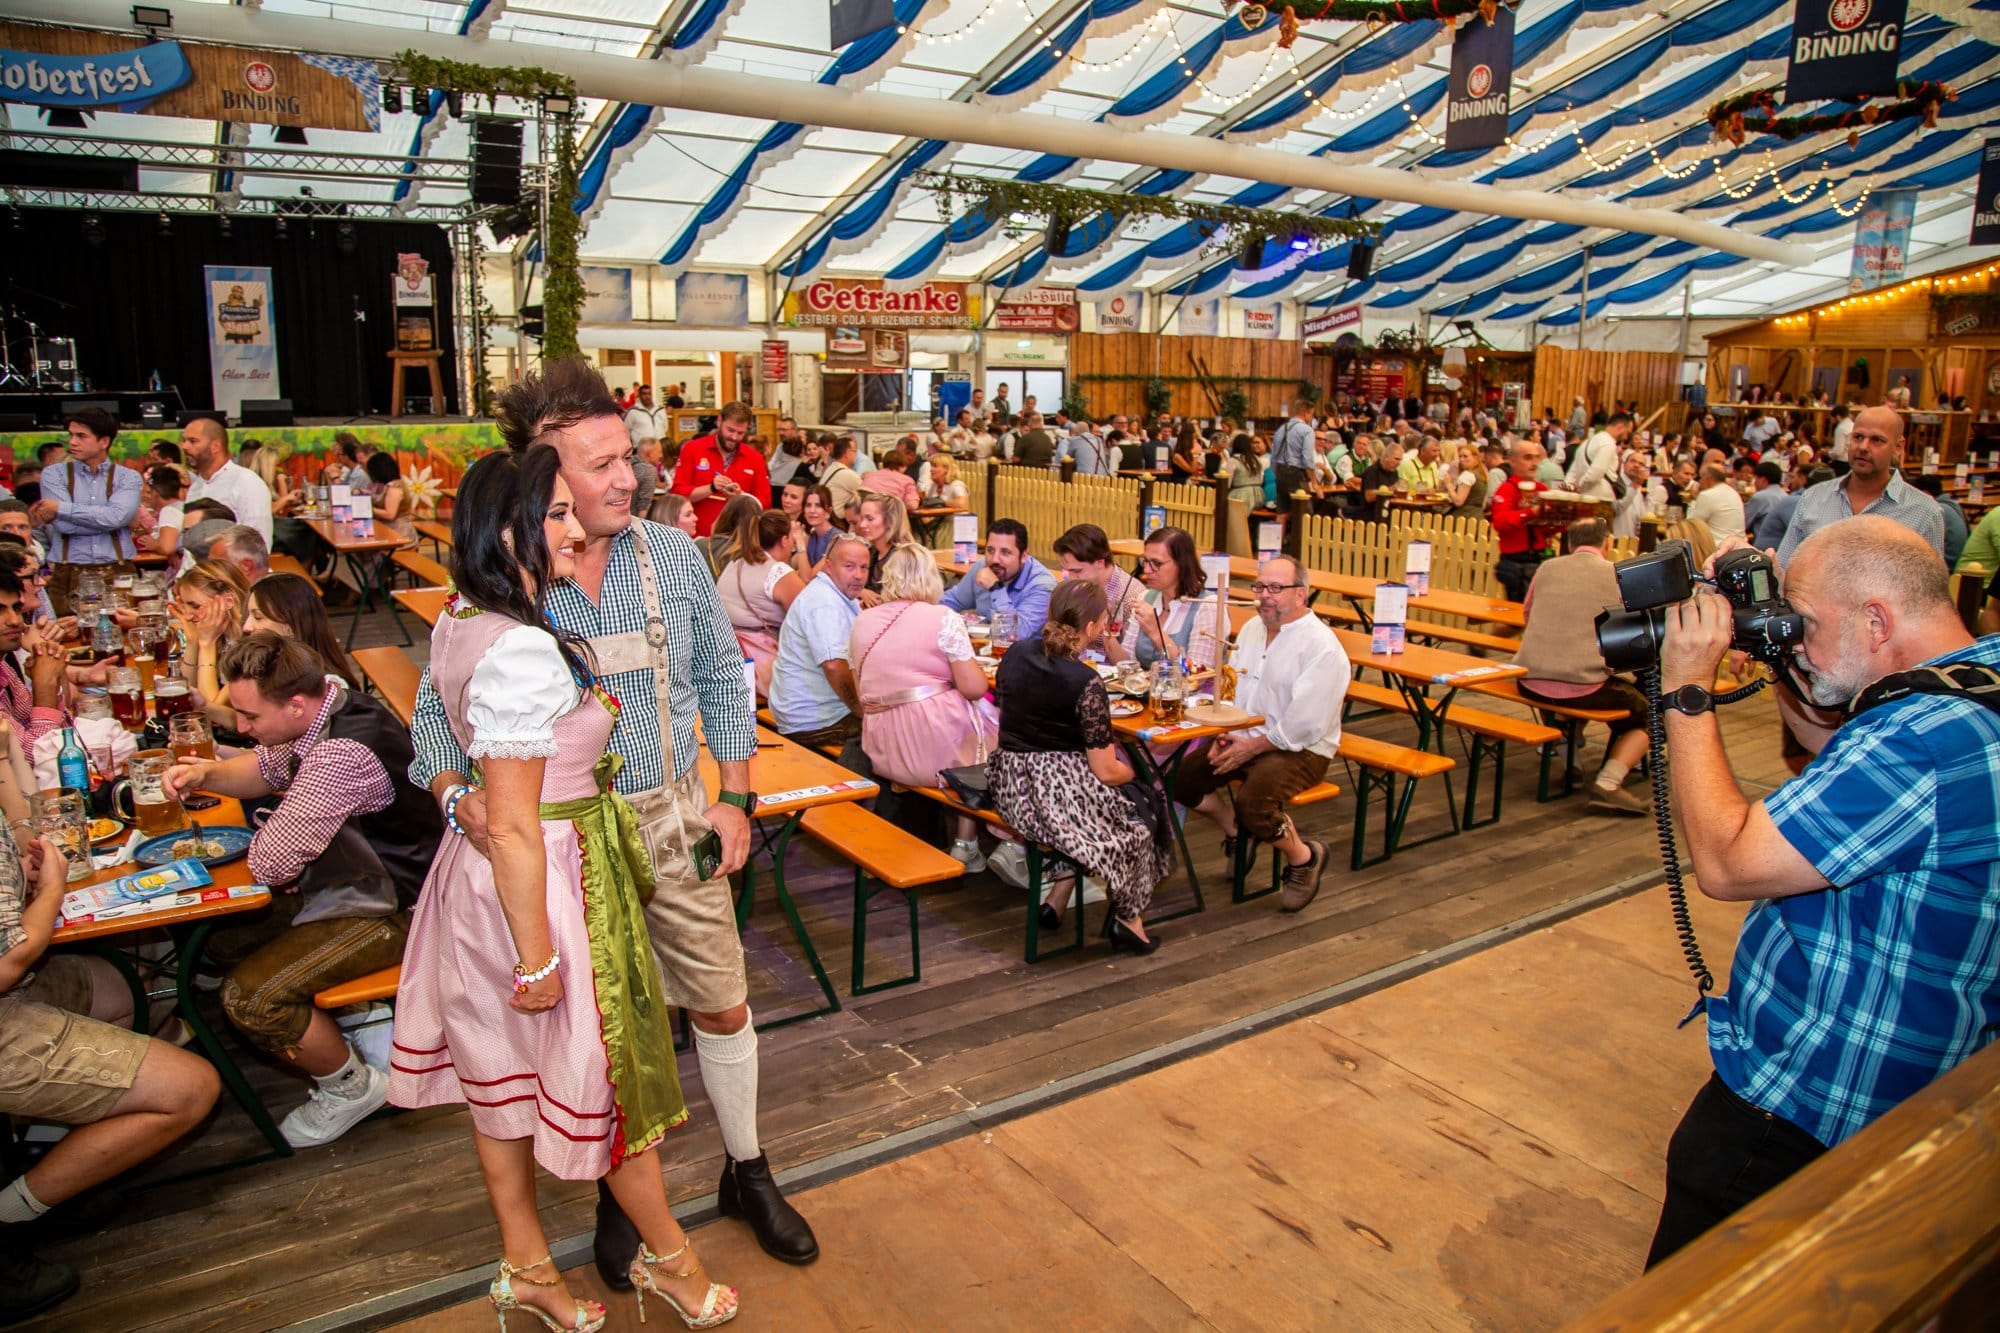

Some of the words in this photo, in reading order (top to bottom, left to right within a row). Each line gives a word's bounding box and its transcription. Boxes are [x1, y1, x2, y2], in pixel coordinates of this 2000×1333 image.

[1794, 23, 1898, 64] BINDING
[0, 55, 152, 100] oberfest
[222, 90, 300, 115] BINDING
[1449, 93, 1507, 123] BINDING
[1975, 213, 2000, 227] BIN
[842, 314, 867, 325] COLA
[871, 315, 925, 326] WEIZENBIER
[1101, 314, 1134, 326] BINDING
[1304, 310, 1359, 334] Mispelchen
